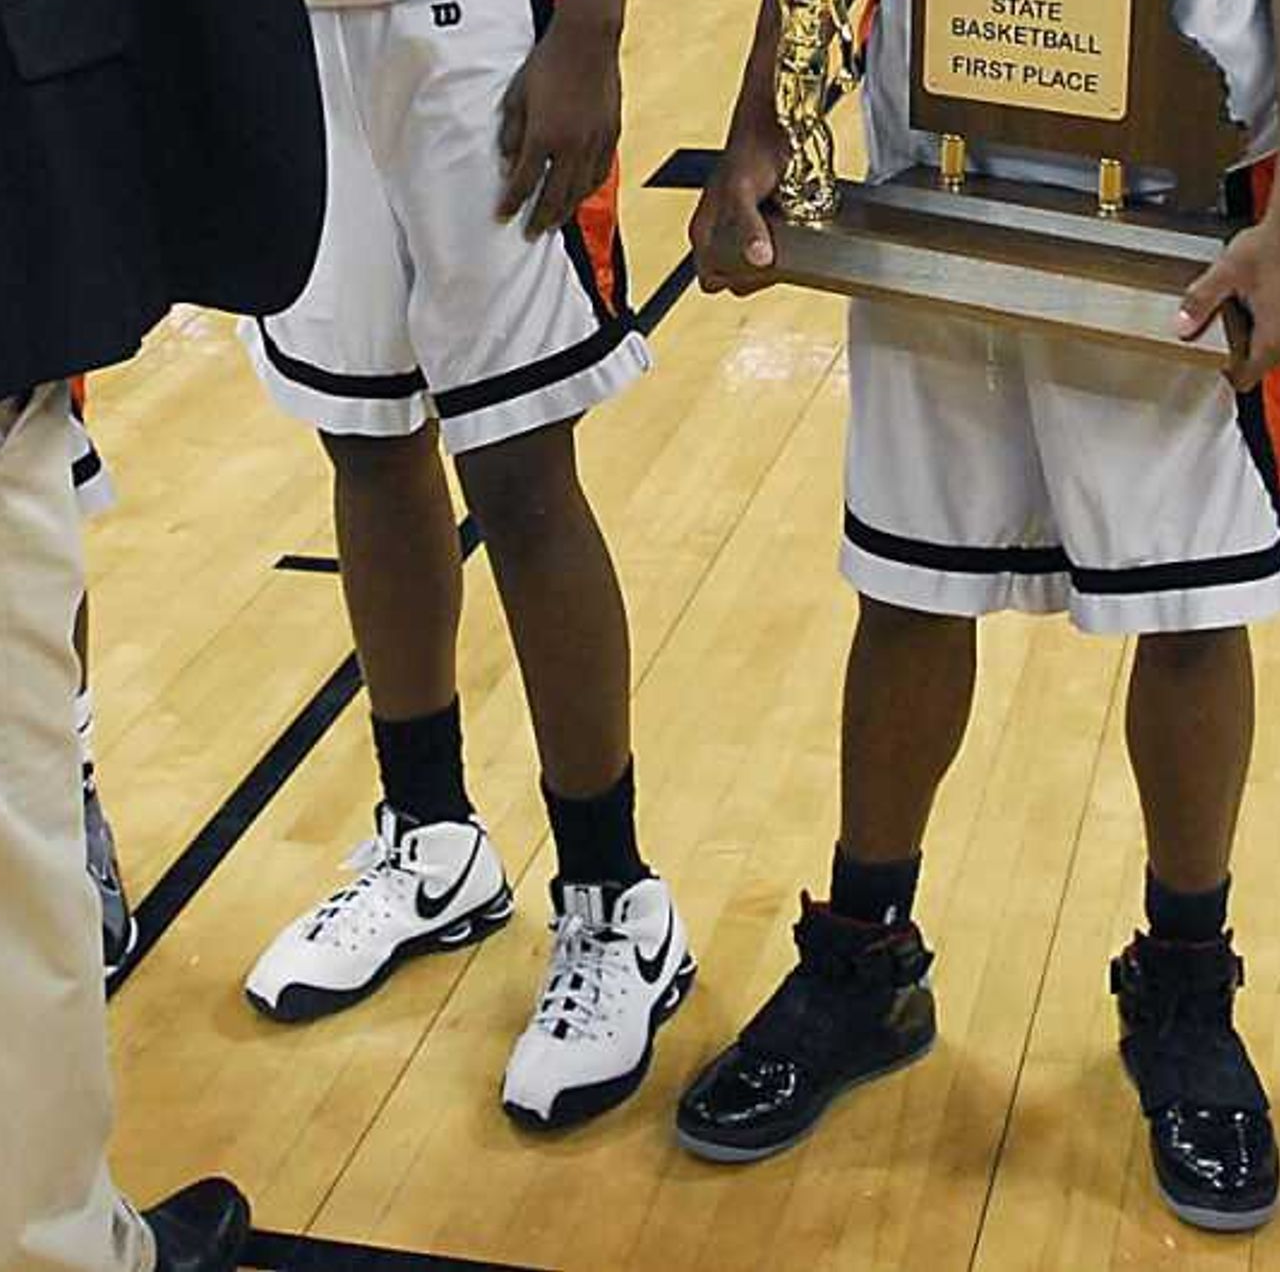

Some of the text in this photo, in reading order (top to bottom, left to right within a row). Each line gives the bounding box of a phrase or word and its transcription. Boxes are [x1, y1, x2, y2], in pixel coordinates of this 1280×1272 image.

[950, 17, 1102, 55] BASKETBALL
[951, 55, 1100, 93] FIRST PLACE
